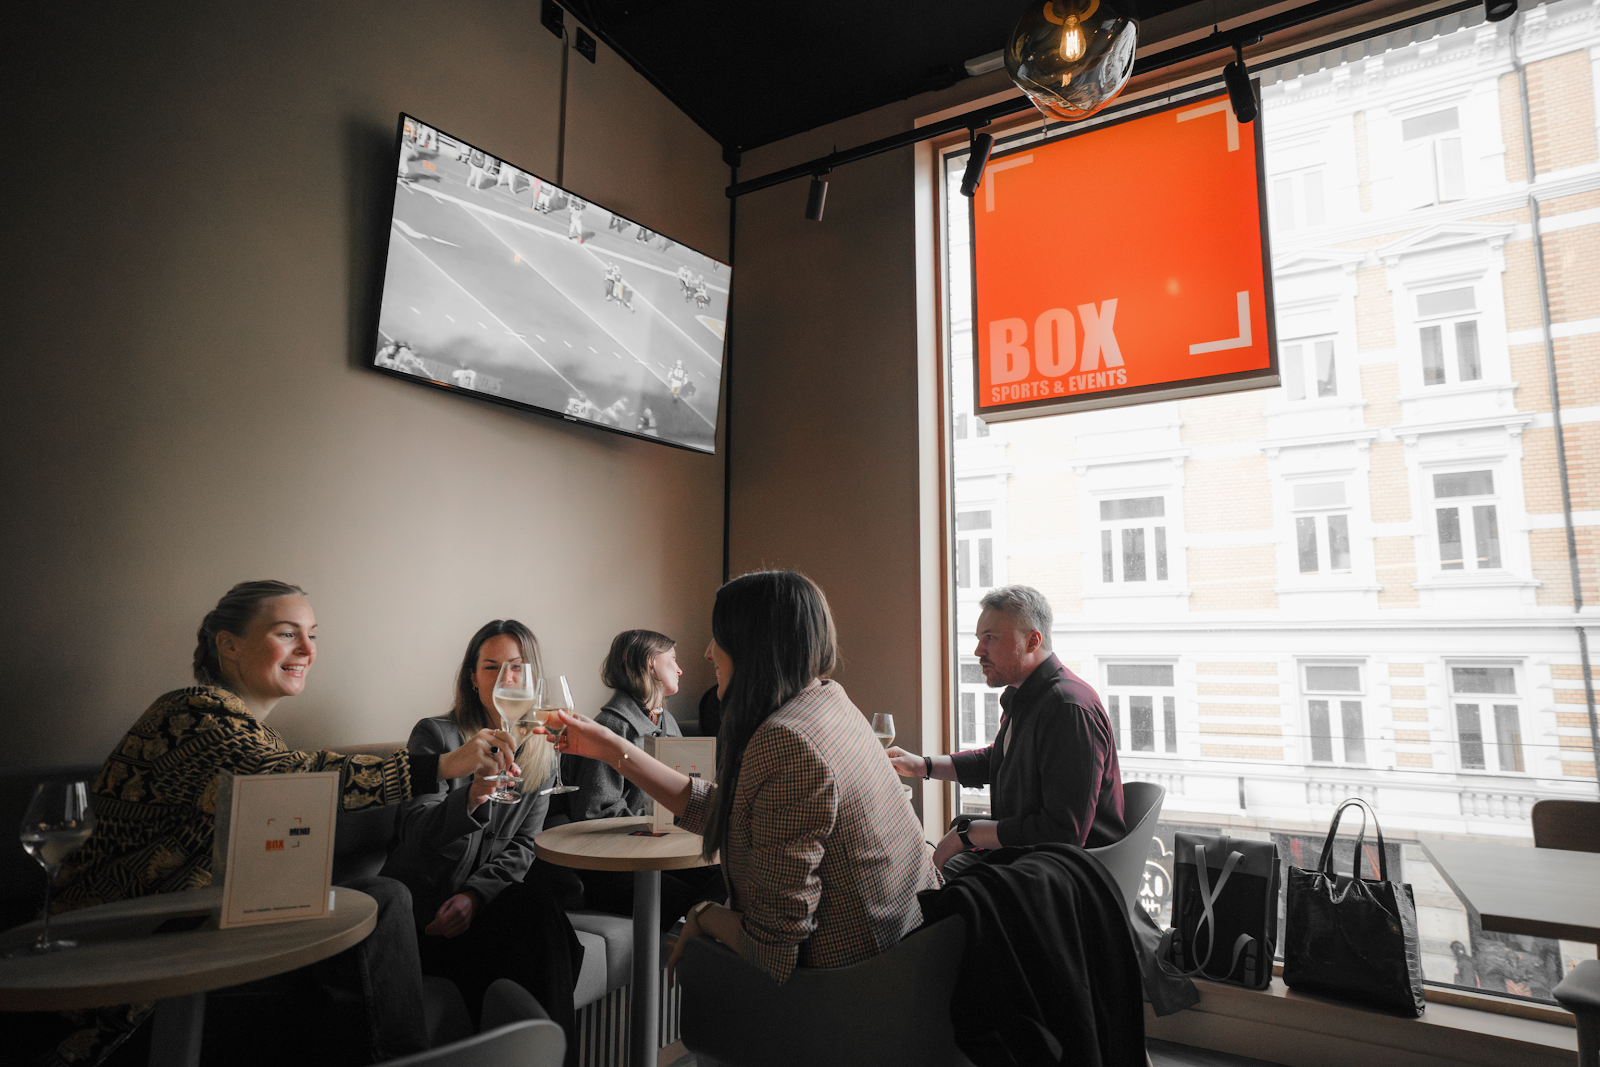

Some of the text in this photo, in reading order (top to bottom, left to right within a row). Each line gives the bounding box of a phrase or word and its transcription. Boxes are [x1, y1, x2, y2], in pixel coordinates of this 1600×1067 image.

[988, 298, 1125, 386] BOX
[991, 369, 1128, 403] SPORTS & EVENTS
[574, 404, 586, 413] 54
[290, 828, 310, 836] MENU
[266, 840, 284, 849] BOX
